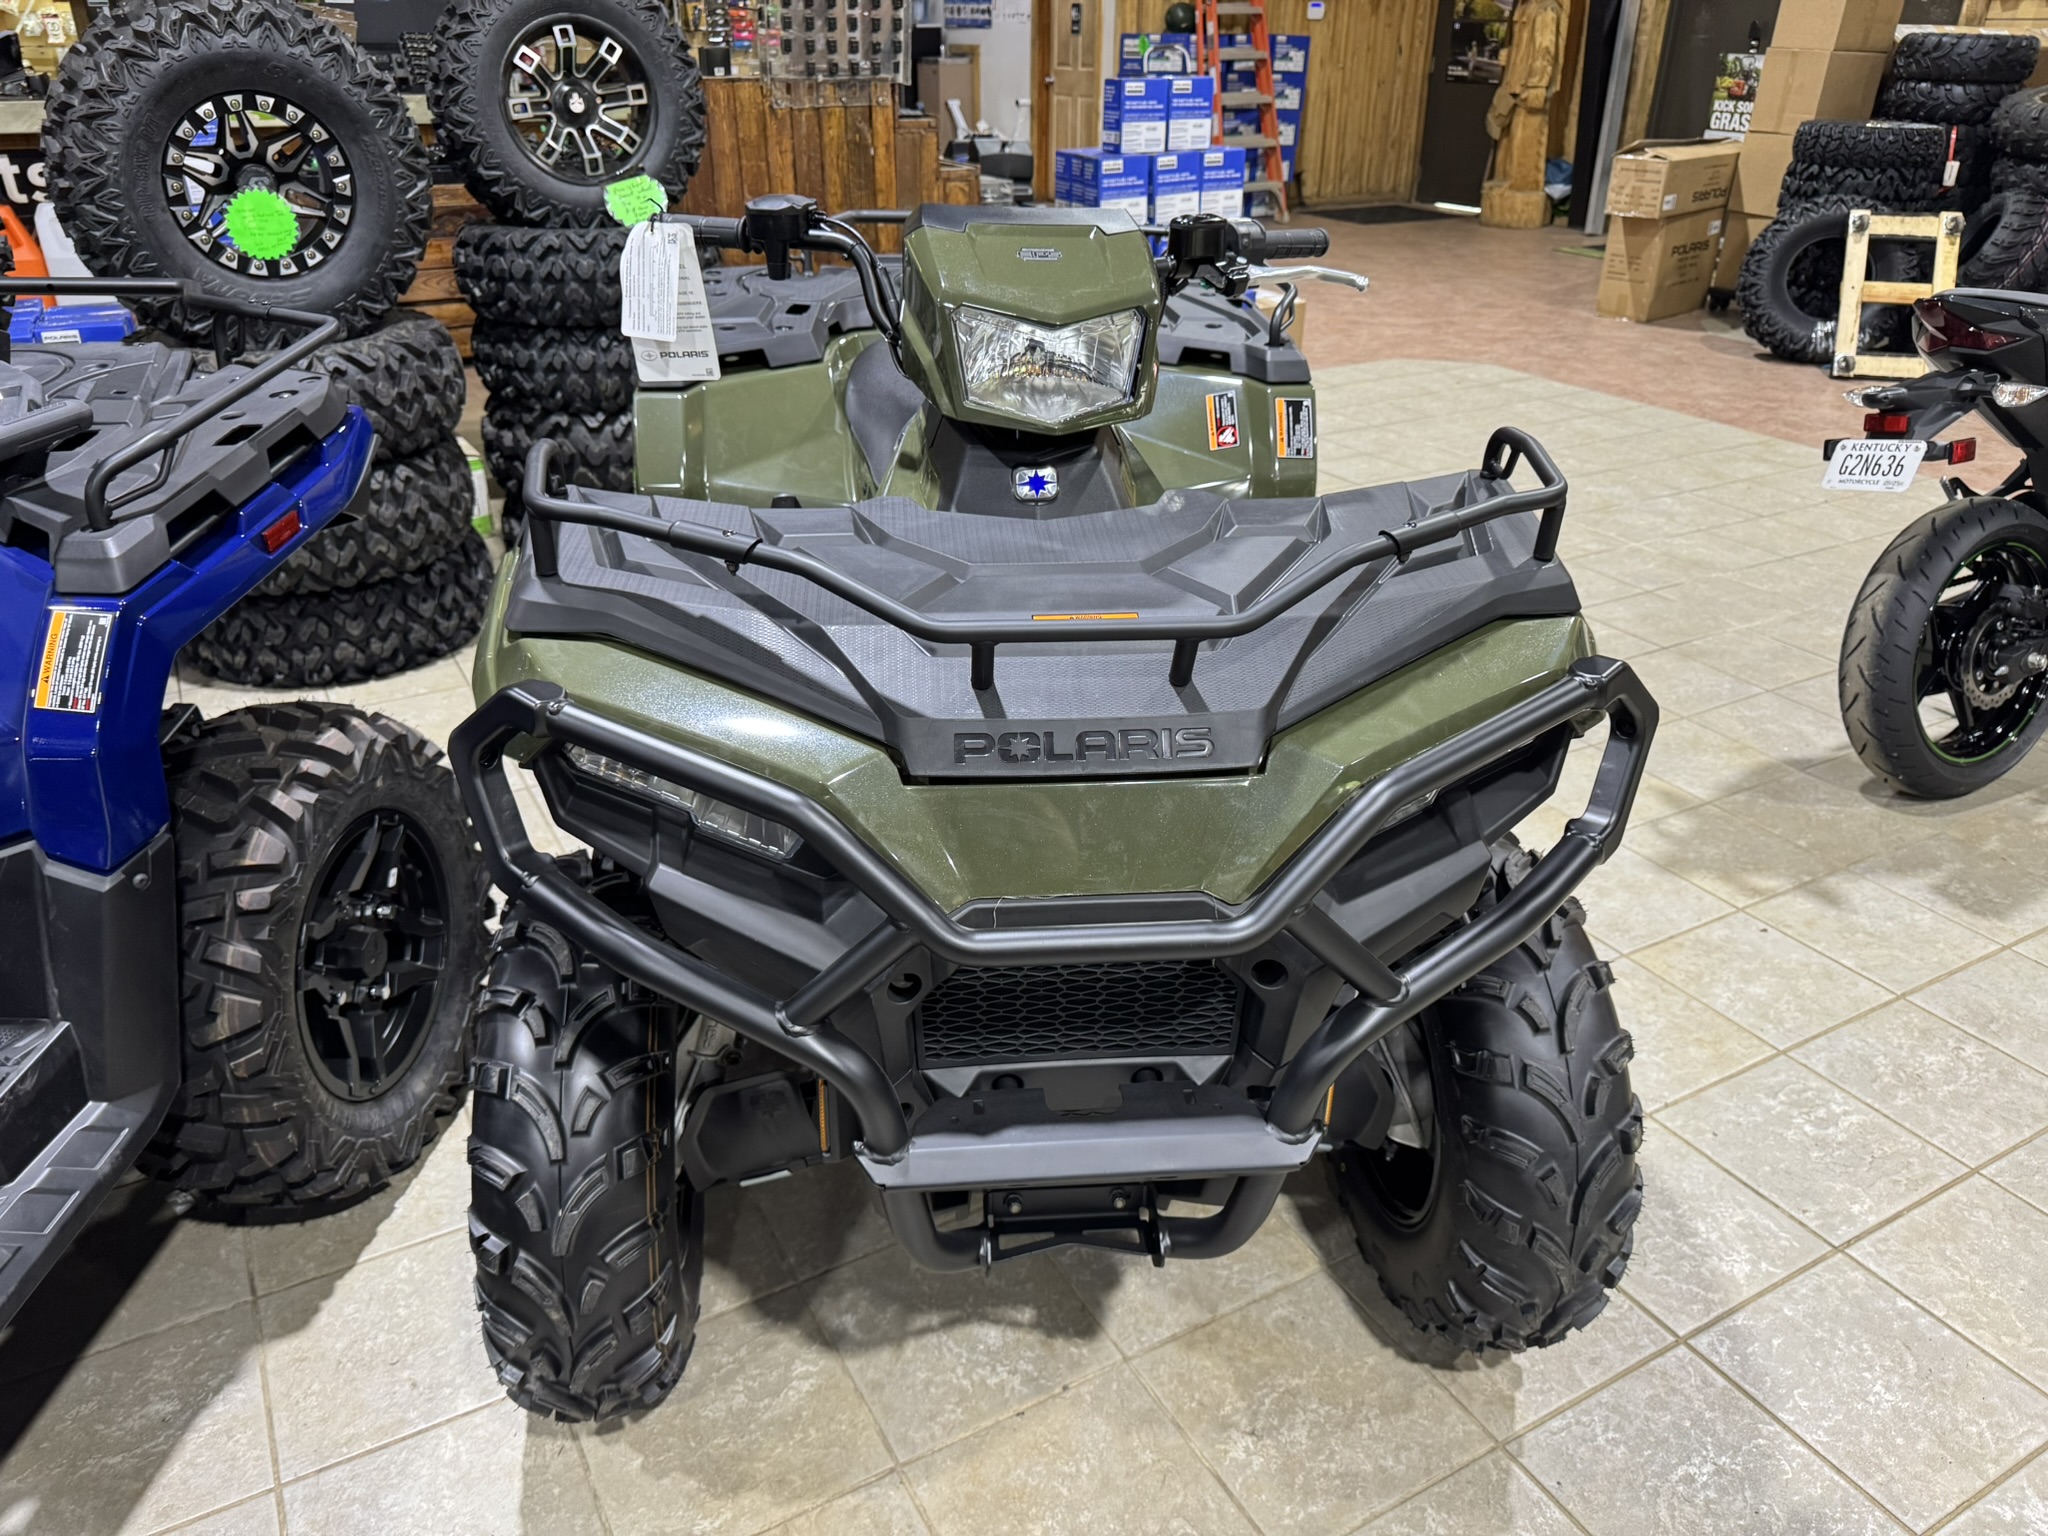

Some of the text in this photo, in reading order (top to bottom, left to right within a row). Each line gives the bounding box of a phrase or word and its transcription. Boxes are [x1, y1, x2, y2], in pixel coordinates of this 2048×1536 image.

[1713, 100, 1736, 112] KICK
[1692, 187, 1728, 203] POLARIS
[1671, 240, 1710, 257] POLARIS
[659, 350, 709, 359] POLARIS
[1851, 443, 1912, 453] KENTUCKY
[1839, 454, 1905, 477] G2N636
[42, 633, 58, 675] WARNING
[953, 727, 1215, 765] POLARIS
